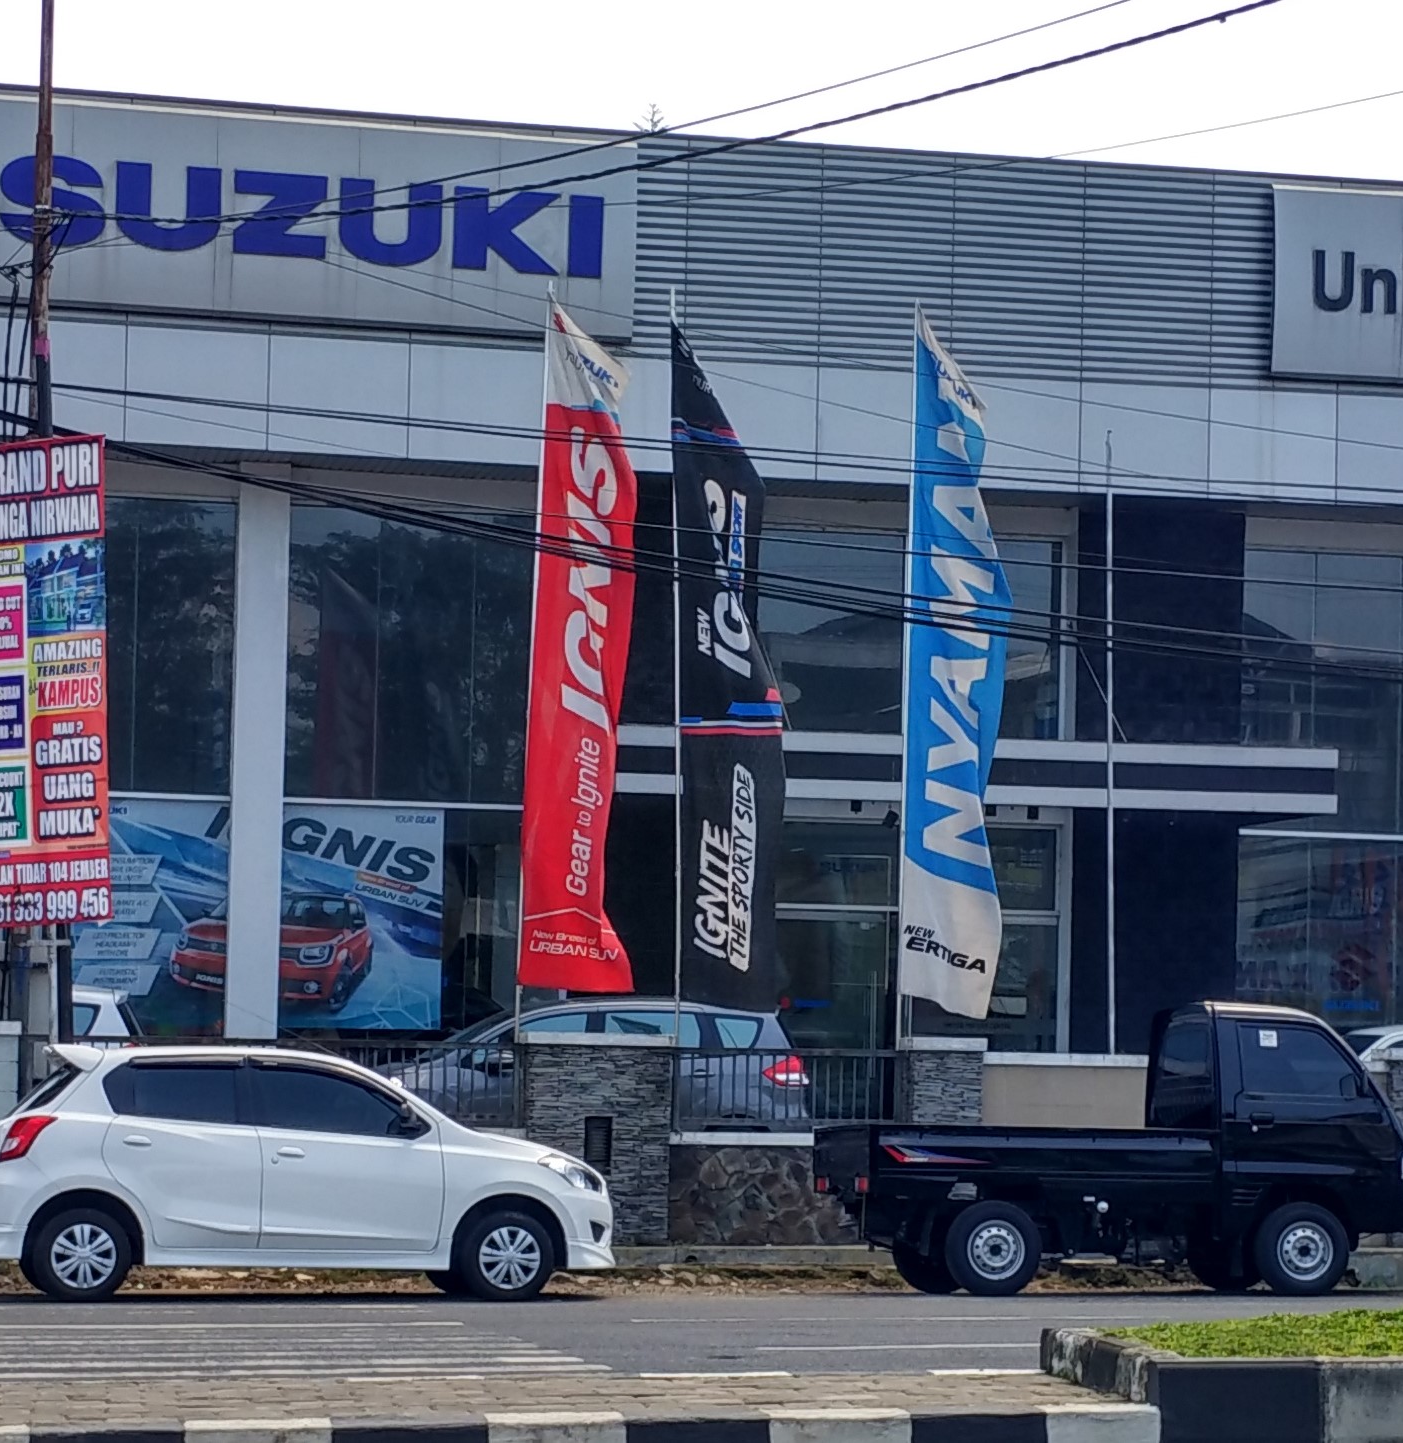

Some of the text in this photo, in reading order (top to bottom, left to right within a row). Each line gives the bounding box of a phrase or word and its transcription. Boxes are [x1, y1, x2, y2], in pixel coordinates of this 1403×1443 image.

[51, 442, 100, 490] PURI
[30, 493, 100, 537] NIRWANA
[561, 425, 618, 737] IGNIS
[696, 607, 712, 656] NEW
[33, 638, 102, 663] AMAZING
[38, 677, 101, 708] KAMPUS
[53, 721, 75, 736] MAU
[35, 736, 102, 766] GRATIS
[43, 773, 95, 801] UANG
[415, 815, 437, 825] GEAR
[565, 737, 603, 897] Gear to Ignite
[15, 862, 47, 885] TIDAR
[48, 861, 68, 882] 104
[70, 858, 109, 881] JEMBER
[729, 769, 754, 960] THE SPORTY SIDE
[46, 889, 78, 920] 999
[80, 886, 109, 918] 456
[355, 883, 424, 908] URBAN SUV
[694, 818, 731, 960] IGNITE
[532, 929, 598, 945] New Breed of
[904, 924, 935, 939] NEW
[529, 940, 619, 962] URBAN SUV
[906, 936, 986, 975] ERTIGA
[195, 972, 224, 985] IGNIS
